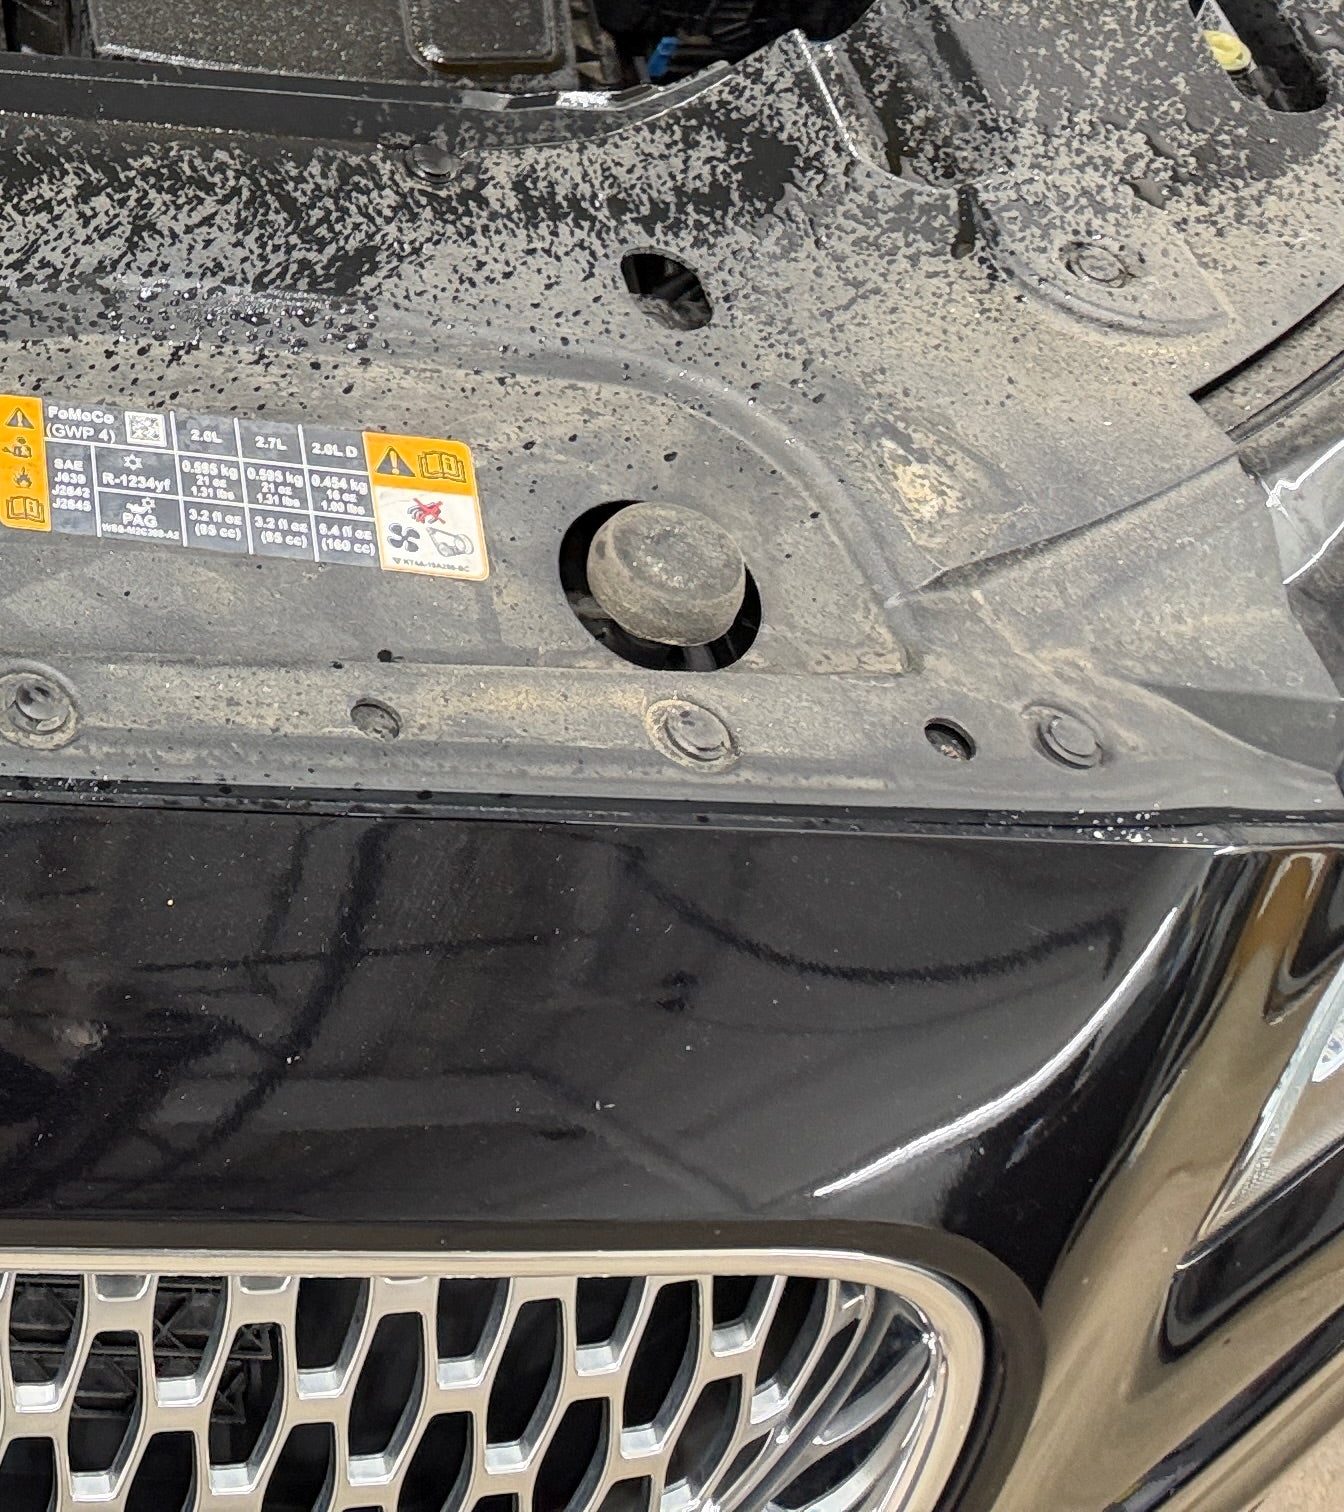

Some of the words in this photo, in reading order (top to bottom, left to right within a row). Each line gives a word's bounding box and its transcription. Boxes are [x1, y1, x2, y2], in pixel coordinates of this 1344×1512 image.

[47, 406, 115, 425] FoMoCo
[45, 422, 95, 440] (GWP
[98, 428, 116, 444] 4)
[255, 435, 288, 451] 2.7L
[346, 445, 358, 458] D
[53, 458, 84, 472] SAE
[220, 463, 239, 481] kg
[102, 472, 171, 493] R-1234yf
[195, 474, 211, 486] 21
[212, 478, 227, 488] oz
[286, 471, 304, 488] kg
[350, 478, 368, 496] kg
[261, 482, 275, 493] 21
[277, 485, 293, 496] oz
[342, 493, 357, 503] oz
[122, 512, 158, 528] PAG
[188, 508, 210, 522] 3.2
[211, 510, 223, 523] fl
[224, 514, 243, 526] oz
[254, 515, 276, 530] 3.2
[277, 518, 289, 531] fl
[290, 522, 308, 533] oz
[219, 527, 242, 541] cc)
[285, 534, 308, 548] cc)
[341, 525, 353, 538] fl
[354, 529, 373, 541] oz
[353, 542, 376, 557] cc)
